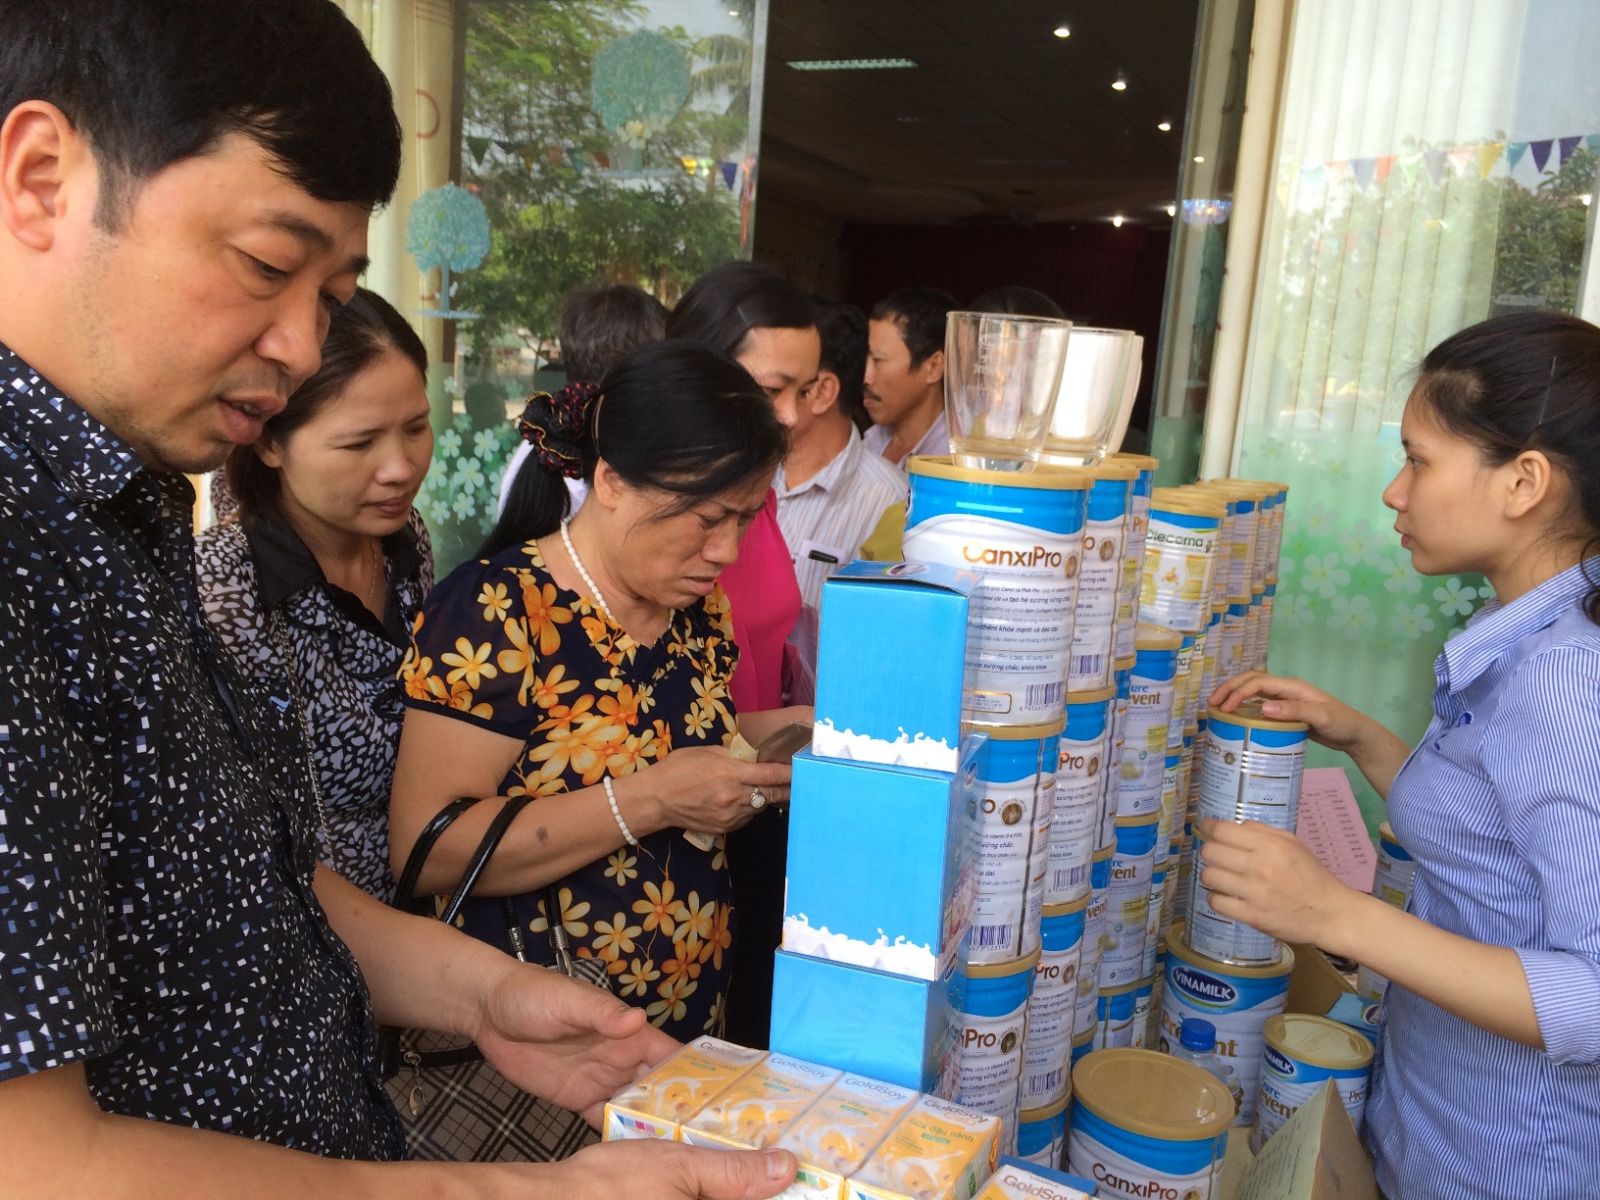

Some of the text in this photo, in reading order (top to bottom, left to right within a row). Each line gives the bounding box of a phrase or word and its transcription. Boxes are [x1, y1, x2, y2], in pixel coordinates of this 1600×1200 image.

[962, 543, 1062, 568] CanxiPro
[1131, 684, 1149, 693] ure
[1175, 969, 1231, 1000] VINAMILK
[845, 1077, 906, 1100] GoldSoy
[1092, 1163, 1178, 1200] CanxiPro
